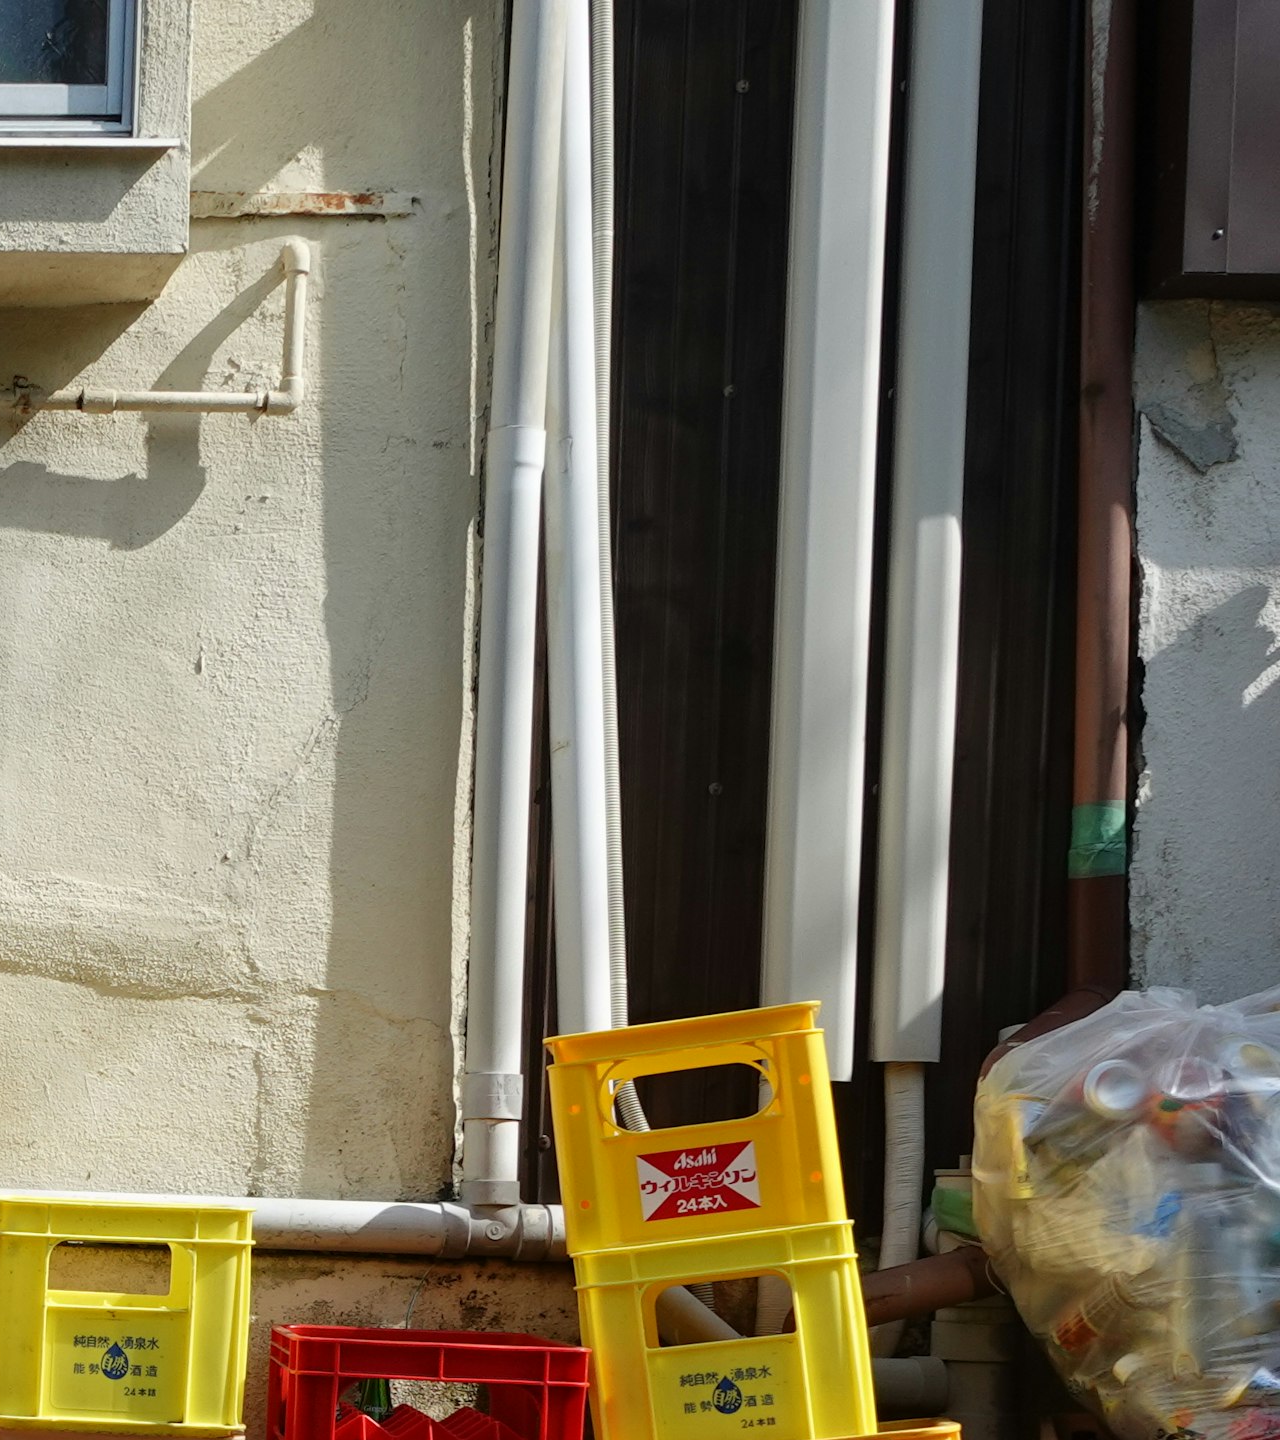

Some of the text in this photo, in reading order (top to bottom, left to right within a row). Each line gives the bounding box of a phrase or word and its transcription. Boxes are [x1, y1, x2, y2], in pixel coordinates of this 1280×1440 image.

[673, 1147, 718, 1170] Asahi
[640, 1168, 756, 1195] ウィルキンソン
[676, 1194, 728, 1214] 24本入
[73, 1335, 111, 1348] 純自然
[129, 1364, 159, 1377] 酒造
